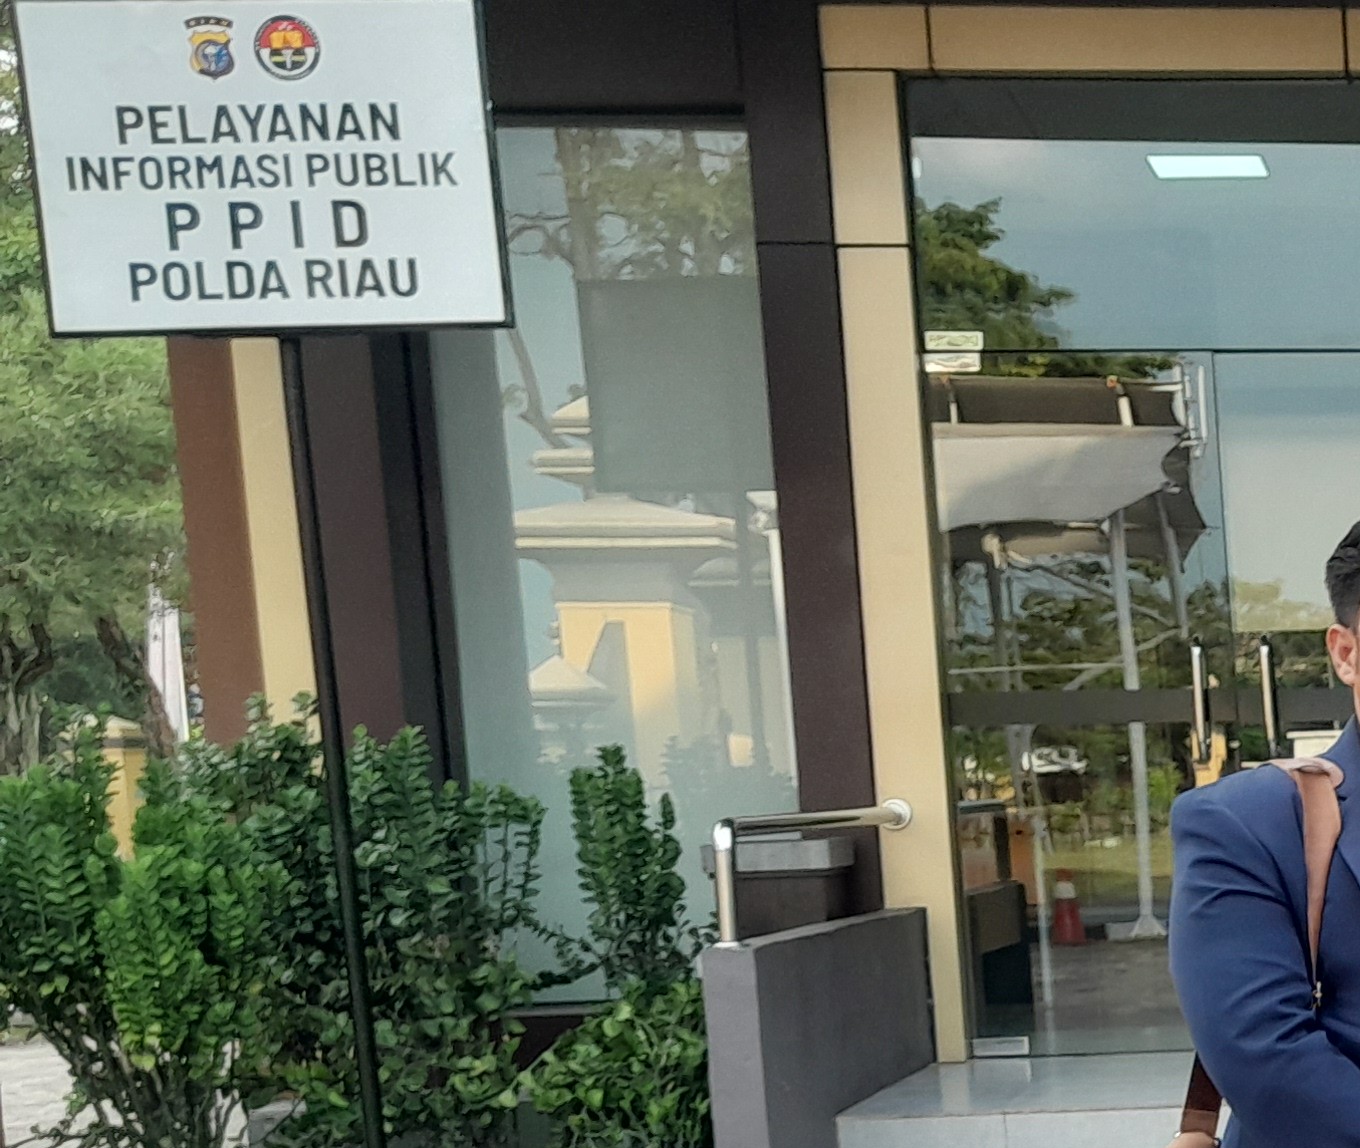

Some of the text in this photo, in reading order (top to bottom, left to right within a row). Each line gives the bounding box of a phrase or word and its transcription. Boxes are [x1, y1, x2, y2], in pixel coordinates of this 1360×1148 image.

[115, 102, 400, 145] PELAYANAN
[66, 151, 458, 191] INFORMASI PUBLIK
[129, 257, 419, 302] POLDA RIAU
